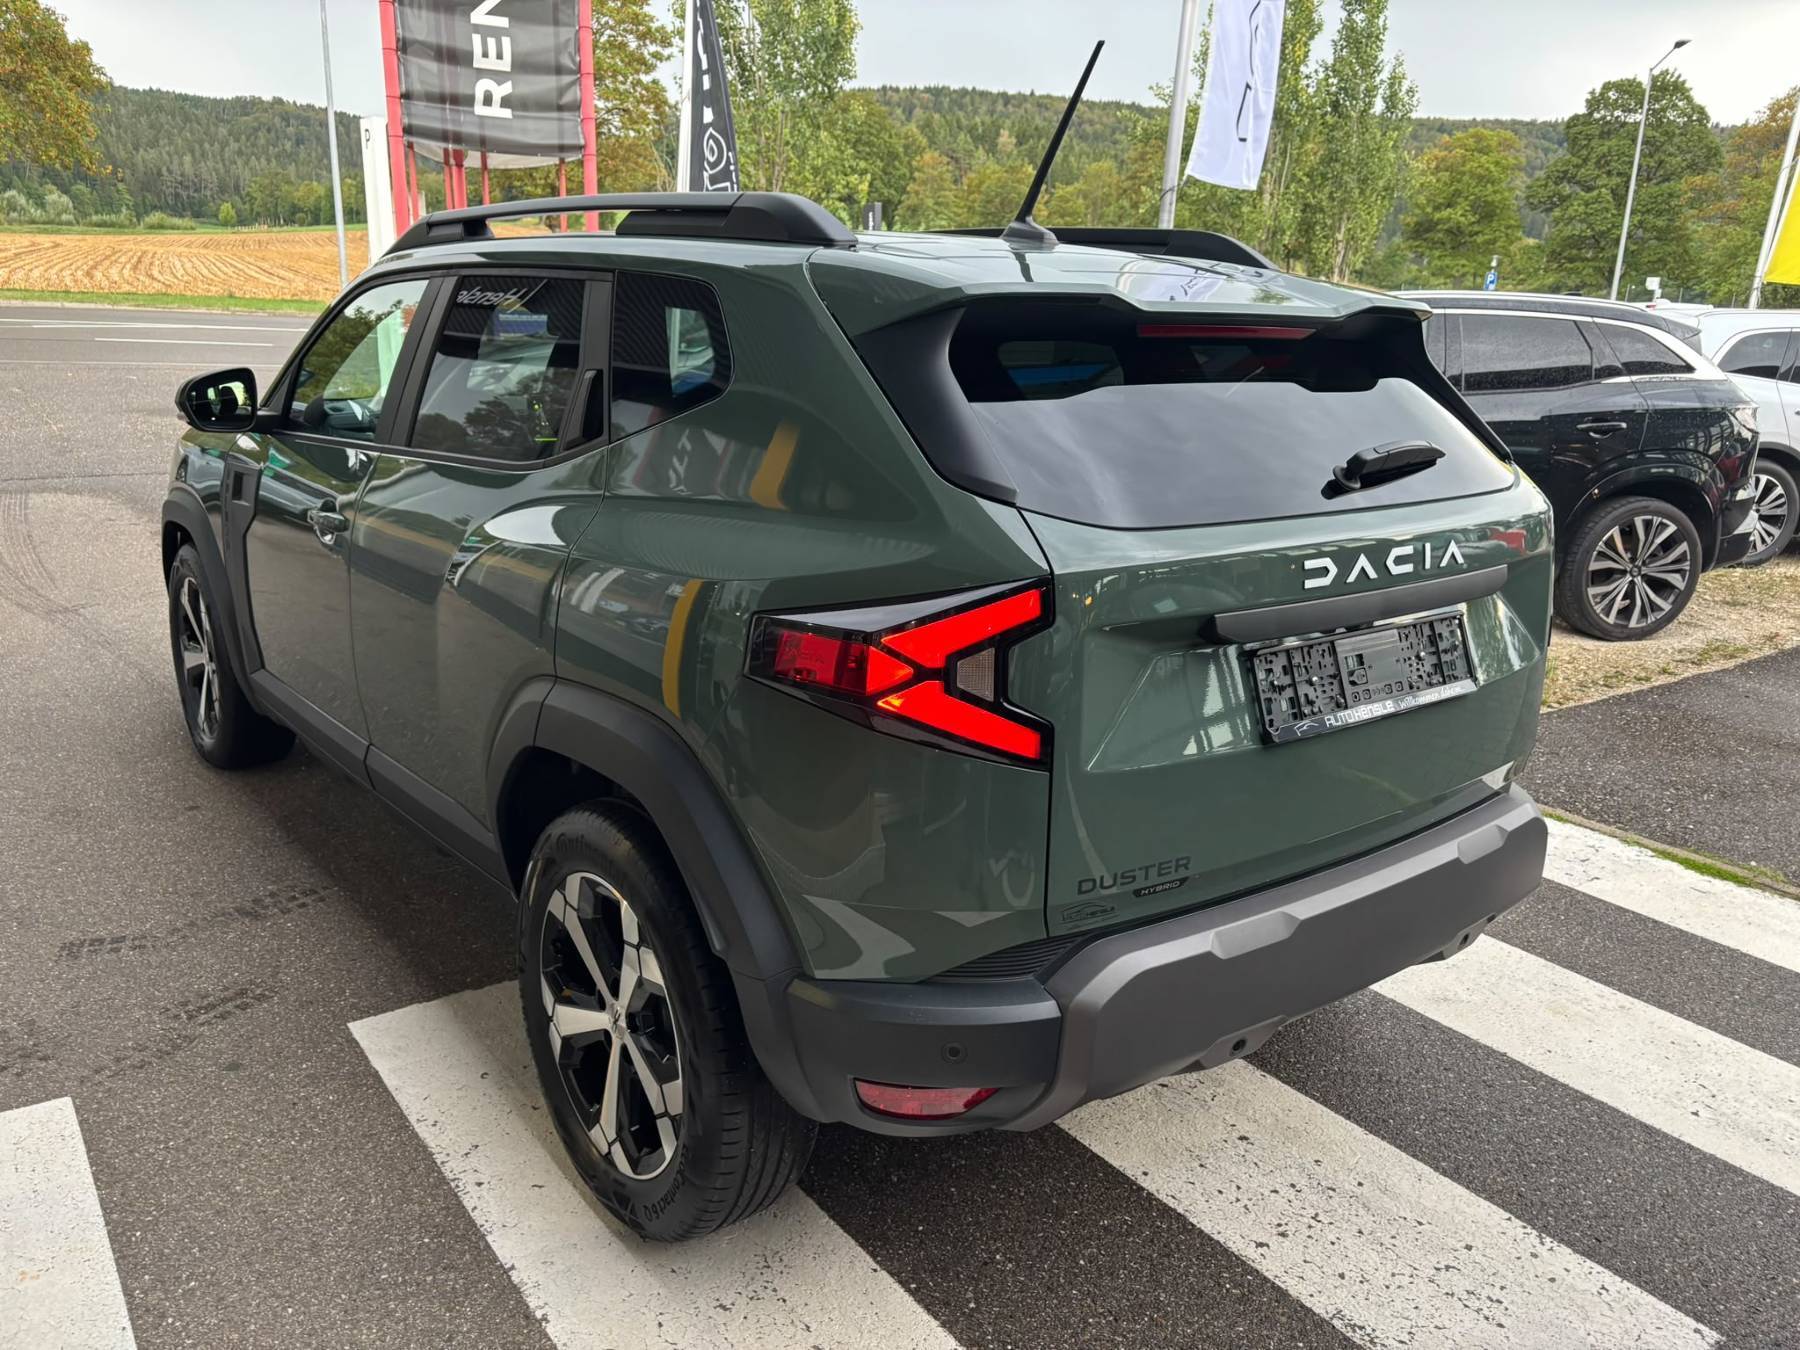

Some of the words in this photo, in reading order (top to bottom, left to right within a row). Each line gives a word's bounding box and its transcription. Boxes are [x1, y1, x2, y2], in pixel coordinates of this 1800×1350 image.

[1486, 273, 1495, 285] P
[1303, 539, 1465, 590] DACIA
[1076, 856, 1192, 896] DUSTER
[1140, 880, 1182, 896] HYBRID
